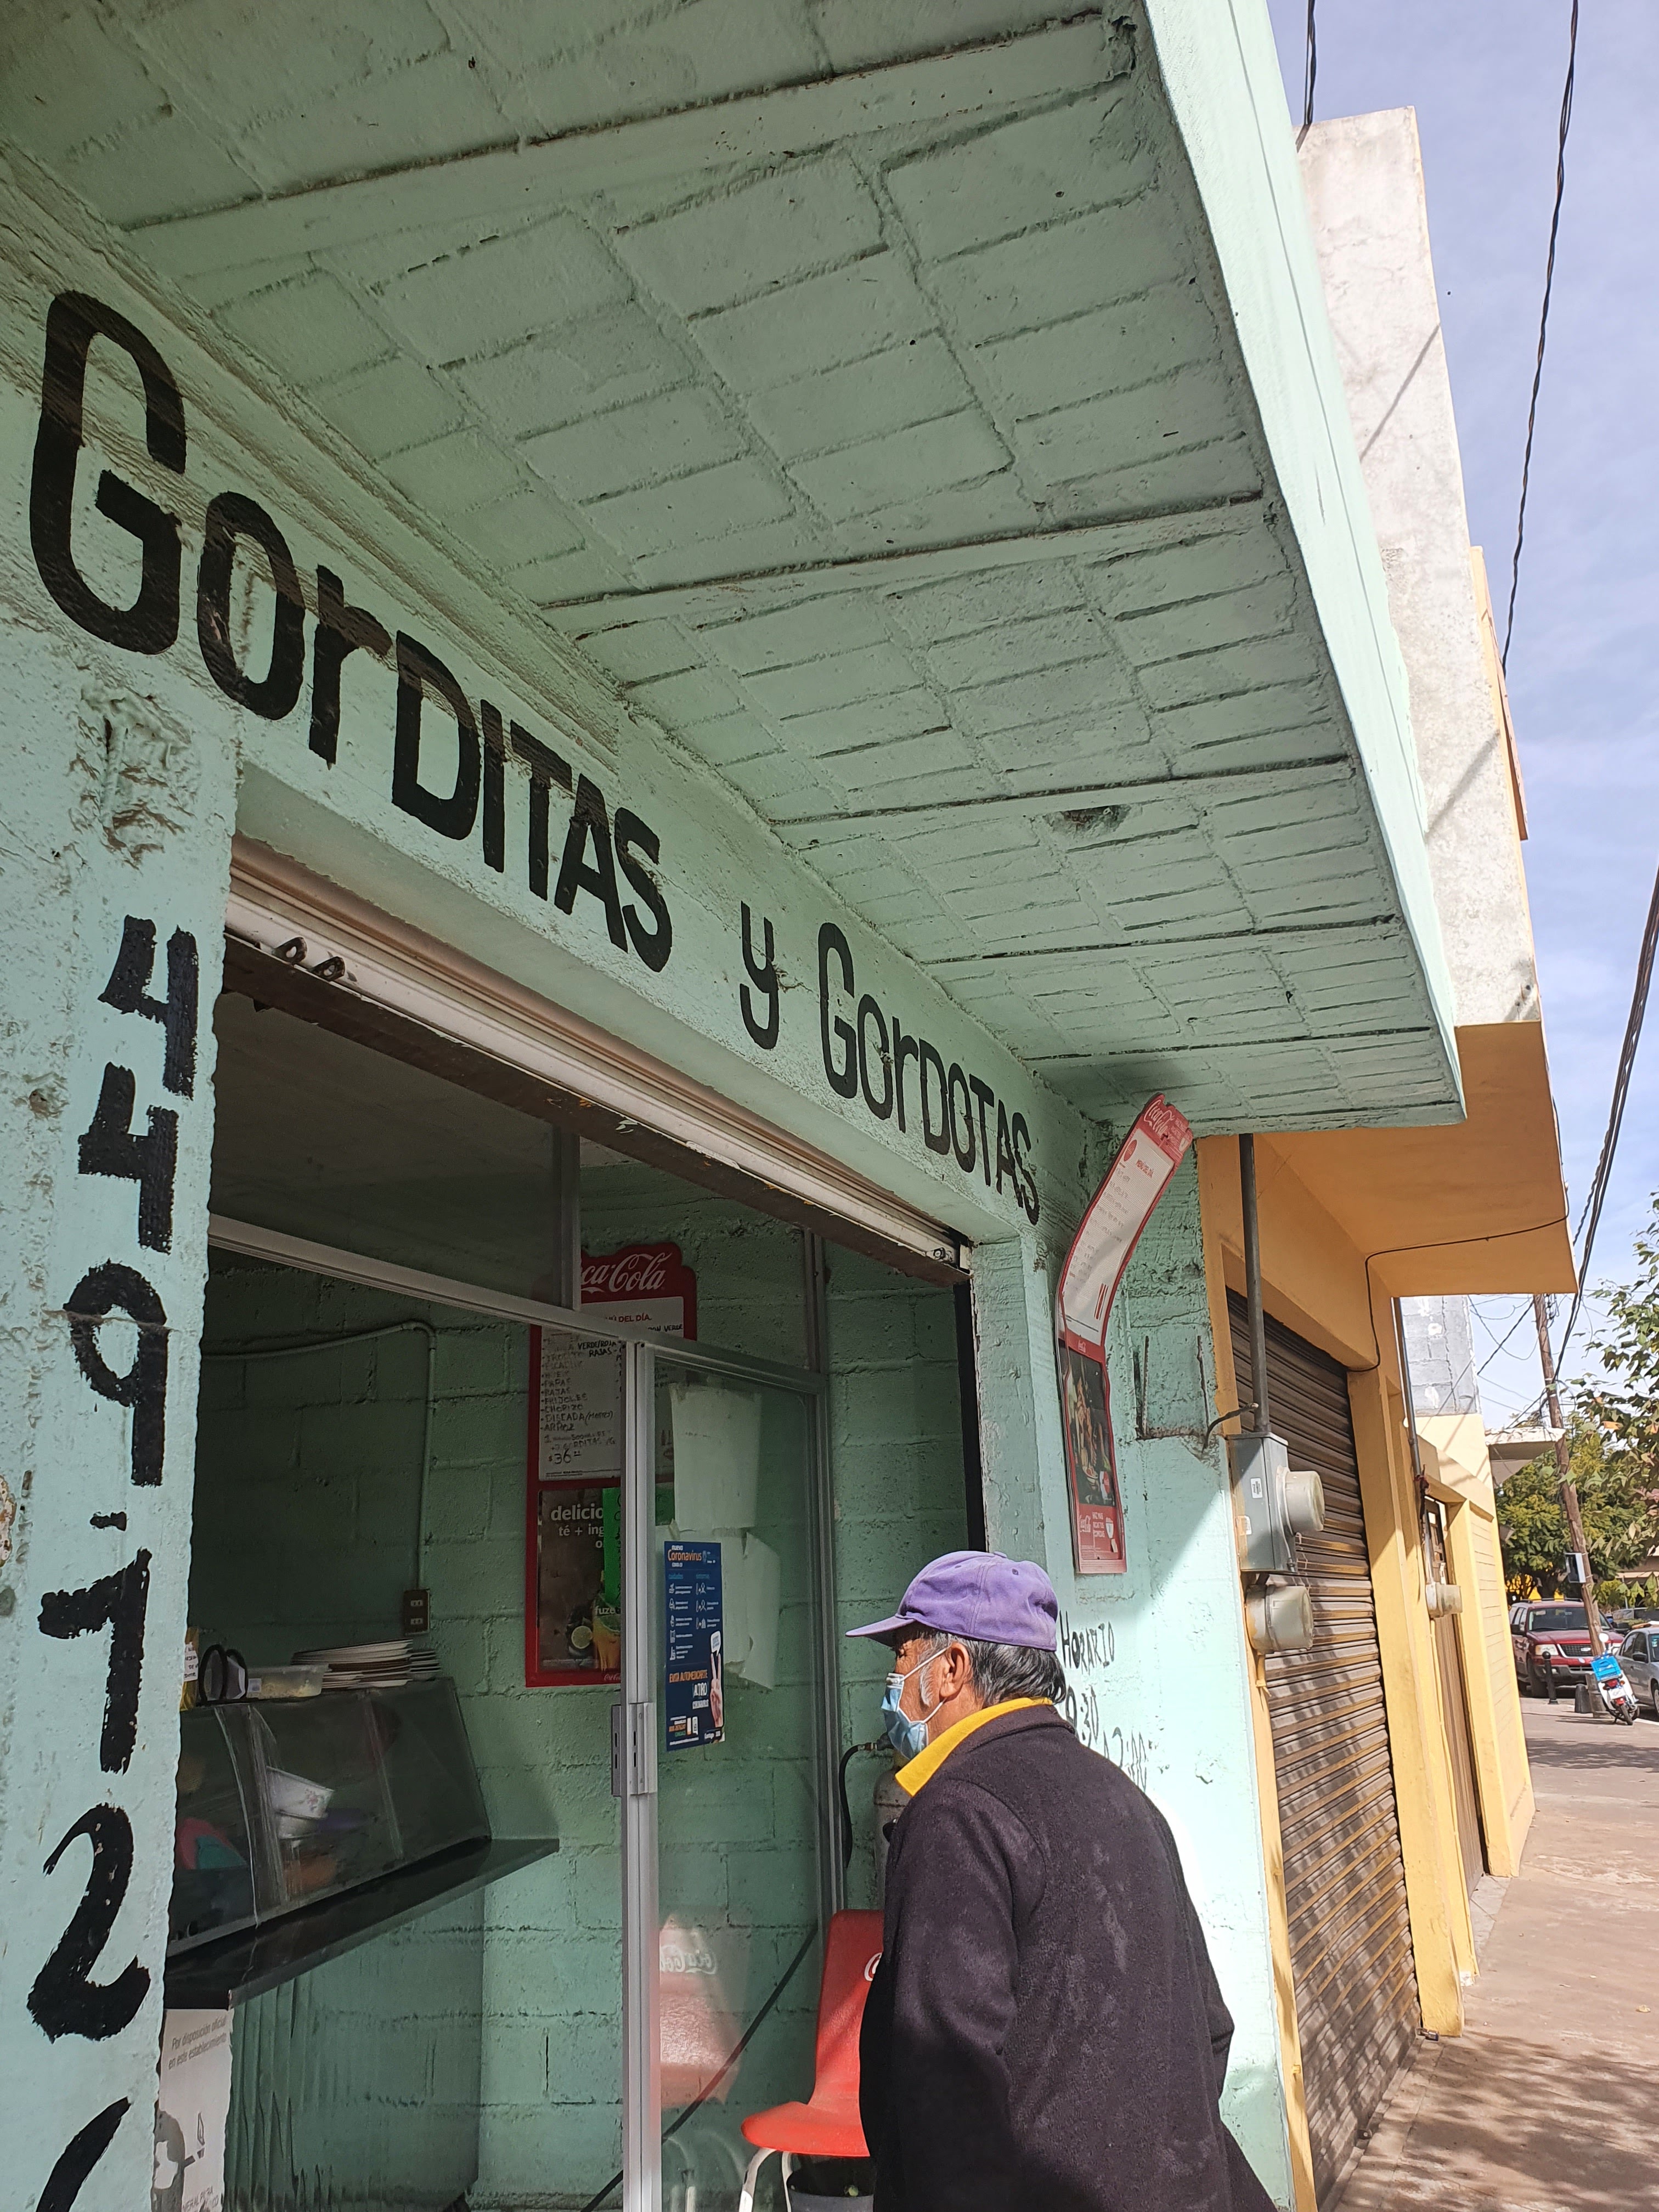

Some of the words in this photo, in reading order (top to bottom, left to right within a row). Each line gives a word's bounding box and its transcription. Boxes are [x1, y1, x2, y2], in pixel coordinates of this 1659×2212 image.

[558, 1525, 570, 1537] té
[668, 1549, 702, 1561] Coronavirus
[1059, 1609, 1114, 1676] HORARIO
